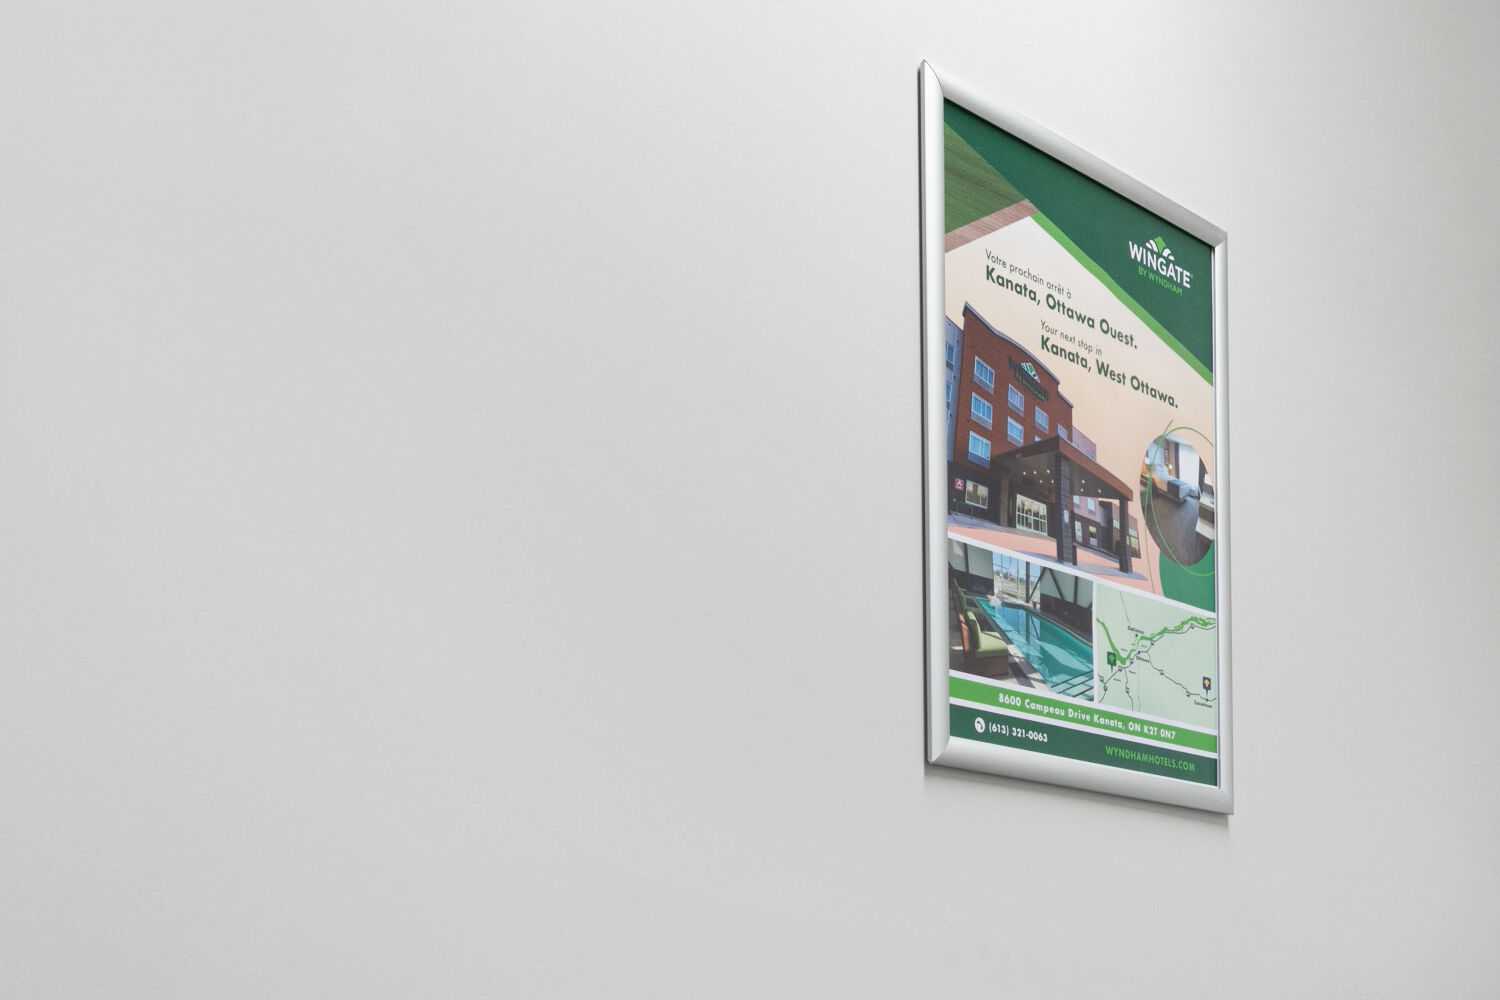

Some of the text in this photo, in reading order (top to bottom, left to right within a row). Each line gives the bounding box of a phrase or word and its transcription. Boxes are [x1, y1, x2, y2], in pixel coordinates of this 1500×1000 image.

[985, 248, 1007, 269] Votre
[1009, 263, 1044, 286] prochain
[1046, 279, 1065, 296] arrêt
[1128, 240, 1191, 289] WINGATE
[1137, 266, 1183, 296] BY WYNDHAM
[986, 264, 1138, 350] Kanata, Ottawa Ouest.
[1040, 319, 1102, 356] Your next stop in
[1041, 334, 1179, 409] Kanata, West Ottawa.
[988, 721, 1048, 743] (613) 321-0063
[998, 692, 1022, 707] 8600
[1024, 699, 1065, 716] Campeau
[1068, 708, 1091, 722] Drive
[1093, 713, 1127, 731] Kanata,
[1128, 721, 1141, 732] ON
[1143, 724, 1158, 736] K2T
[1105, 744, 1196, 772] WYNDHAMHOTELS.COM
